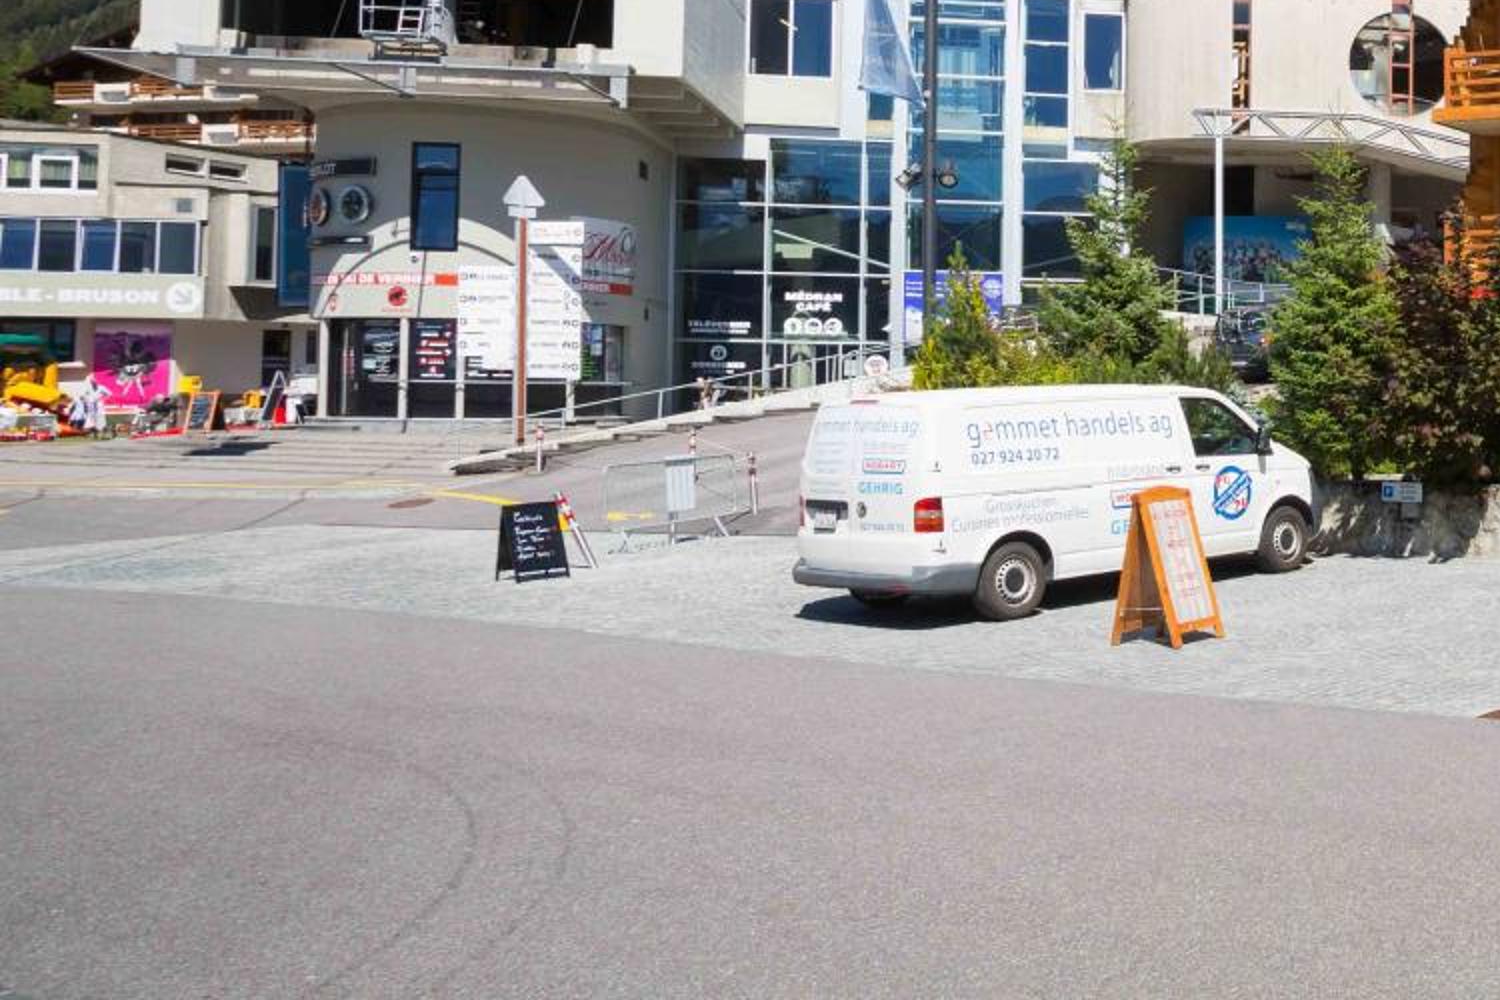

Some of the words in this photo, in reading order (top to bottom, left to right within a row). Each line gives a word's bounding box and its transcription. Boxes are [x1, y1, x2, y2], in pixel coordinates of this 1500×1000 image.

[57, 288, 160, 303] BRUSON
[1063, 409, 1145, 437] handels
[1149, 414, 1173, 438] ag
[971, 451, 995, 466] 027
[999, 449, 1023, 463] 924
[1044, 447, 1060, 460] 72
